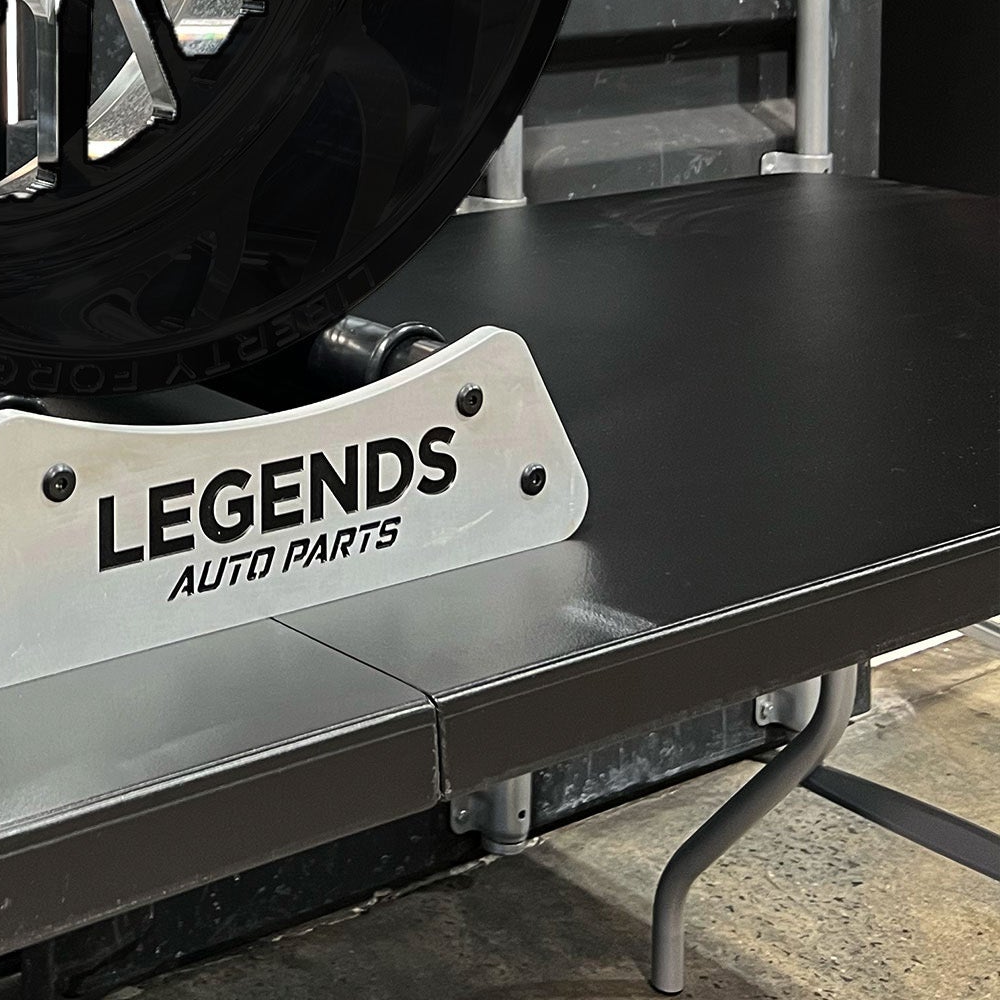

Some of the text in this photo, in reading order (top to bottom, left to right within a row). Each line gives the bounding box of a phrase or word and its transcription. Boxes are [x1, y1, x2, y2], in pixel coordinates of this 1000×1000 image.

[98, 426, 457, 572] LEGENDS
[167, 516, 402, 601] AUTO PARTS
